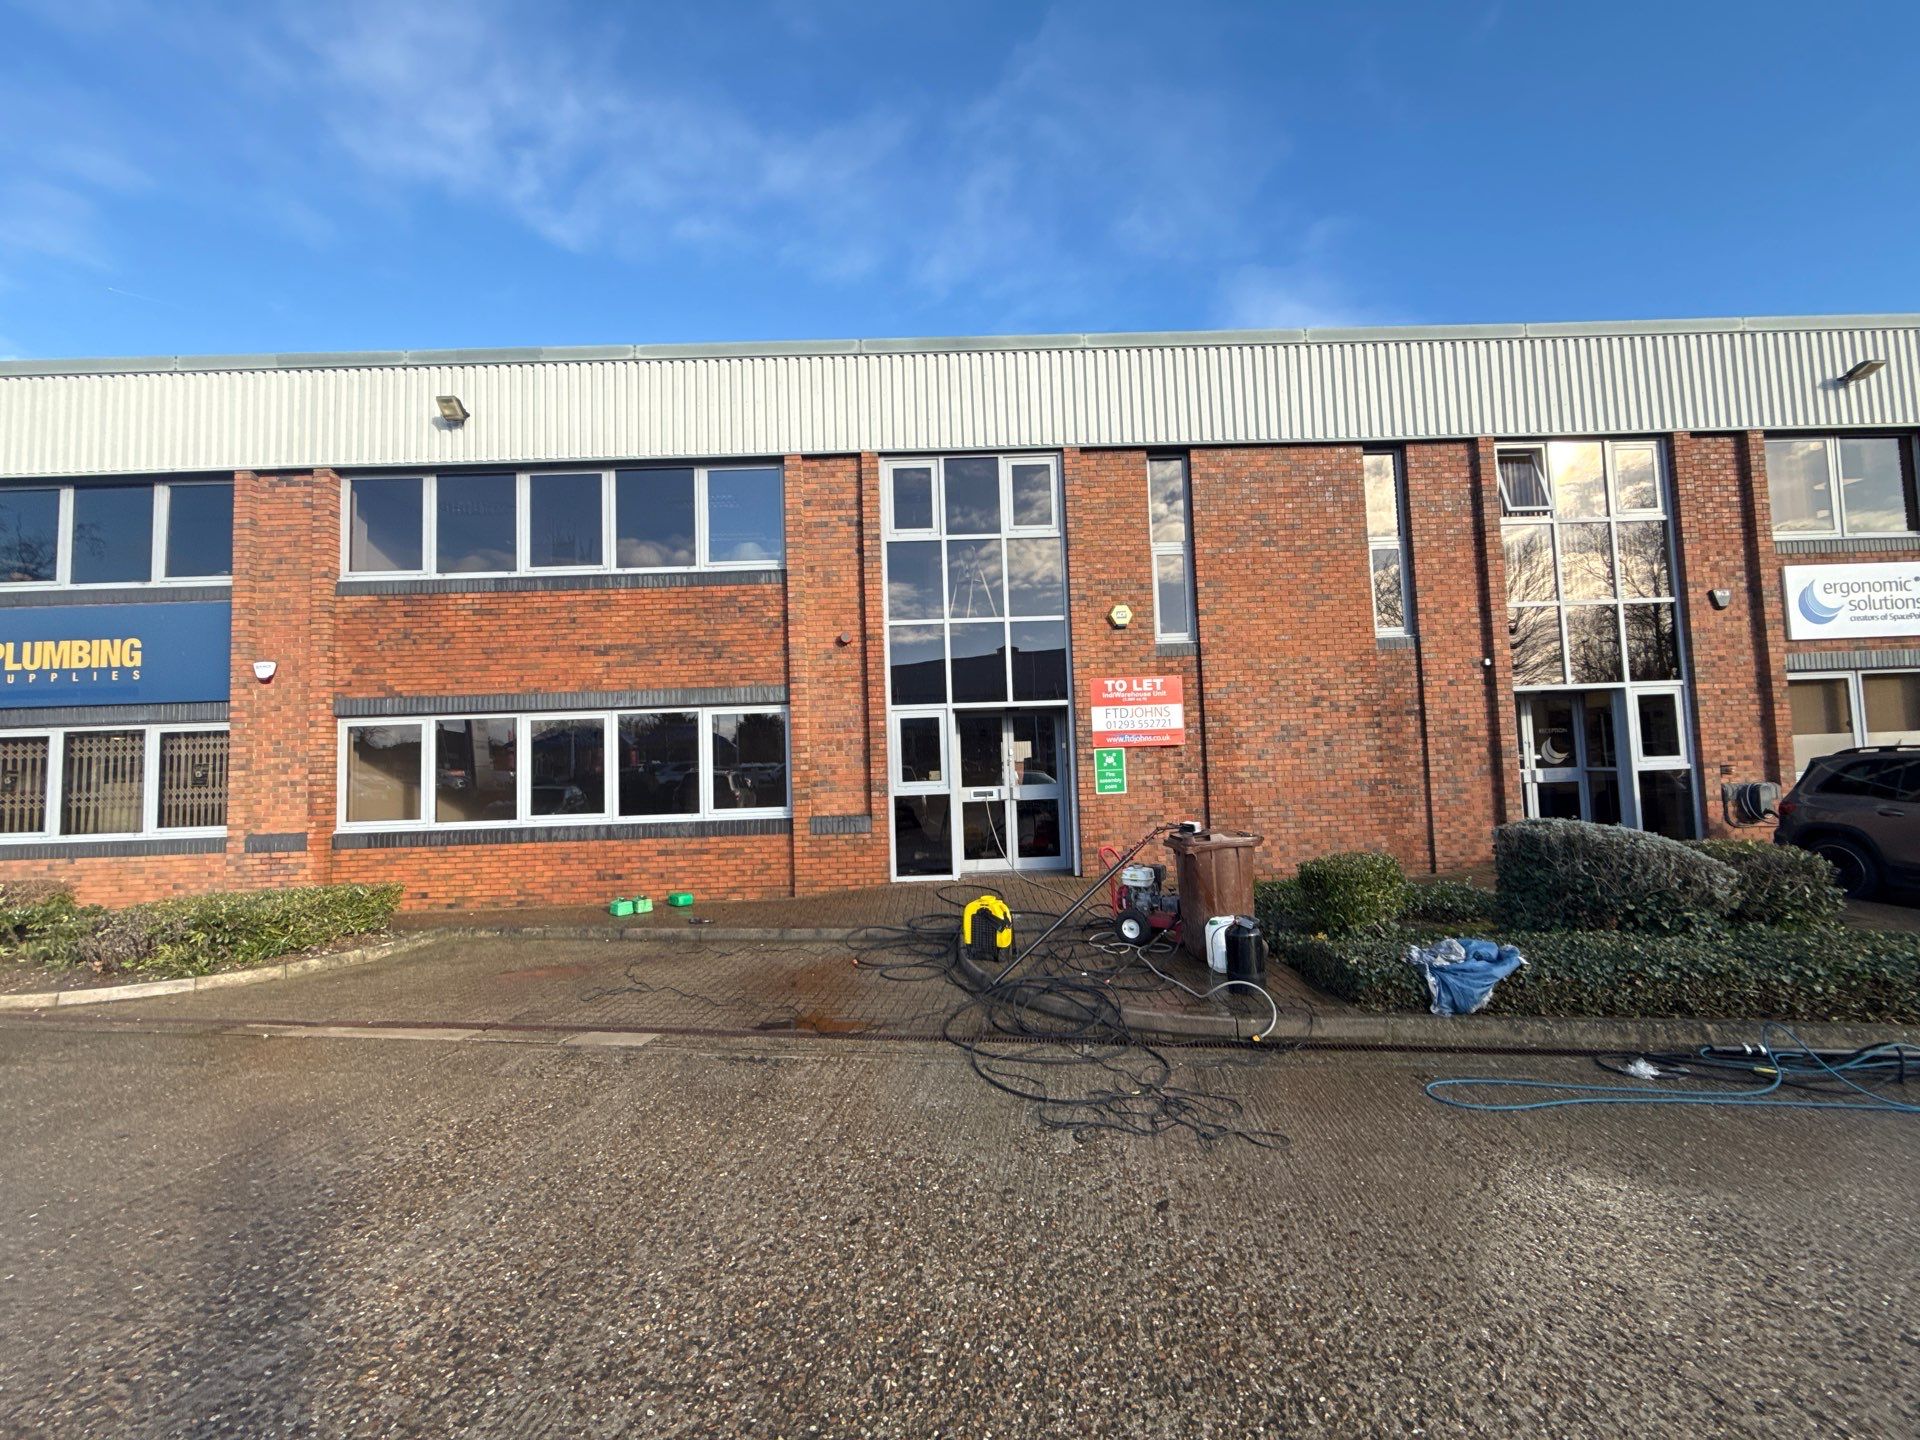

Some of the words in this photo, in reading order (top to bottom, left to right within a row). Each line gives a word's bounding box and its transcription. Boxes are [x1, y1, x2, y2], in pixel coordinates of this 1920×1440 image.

[1823, 576, 1912, 598] ergonomic
[1849, 614, 1880, 622] creators
[1880, 613, 1888, 621] of
[6, 669, 142, 684] UPPLIES
[1103, 679, 1128, 692] TO
[1132, 678, 1164, 691] LET
[1105, 705, 1171, 719] FTDJOHNS
[1105, 719, 1136, 730] 01293
[1137, 718, 1172, 729] 552721
[1106, 733, 1171, 744] www.ftdjohns.co.uk
